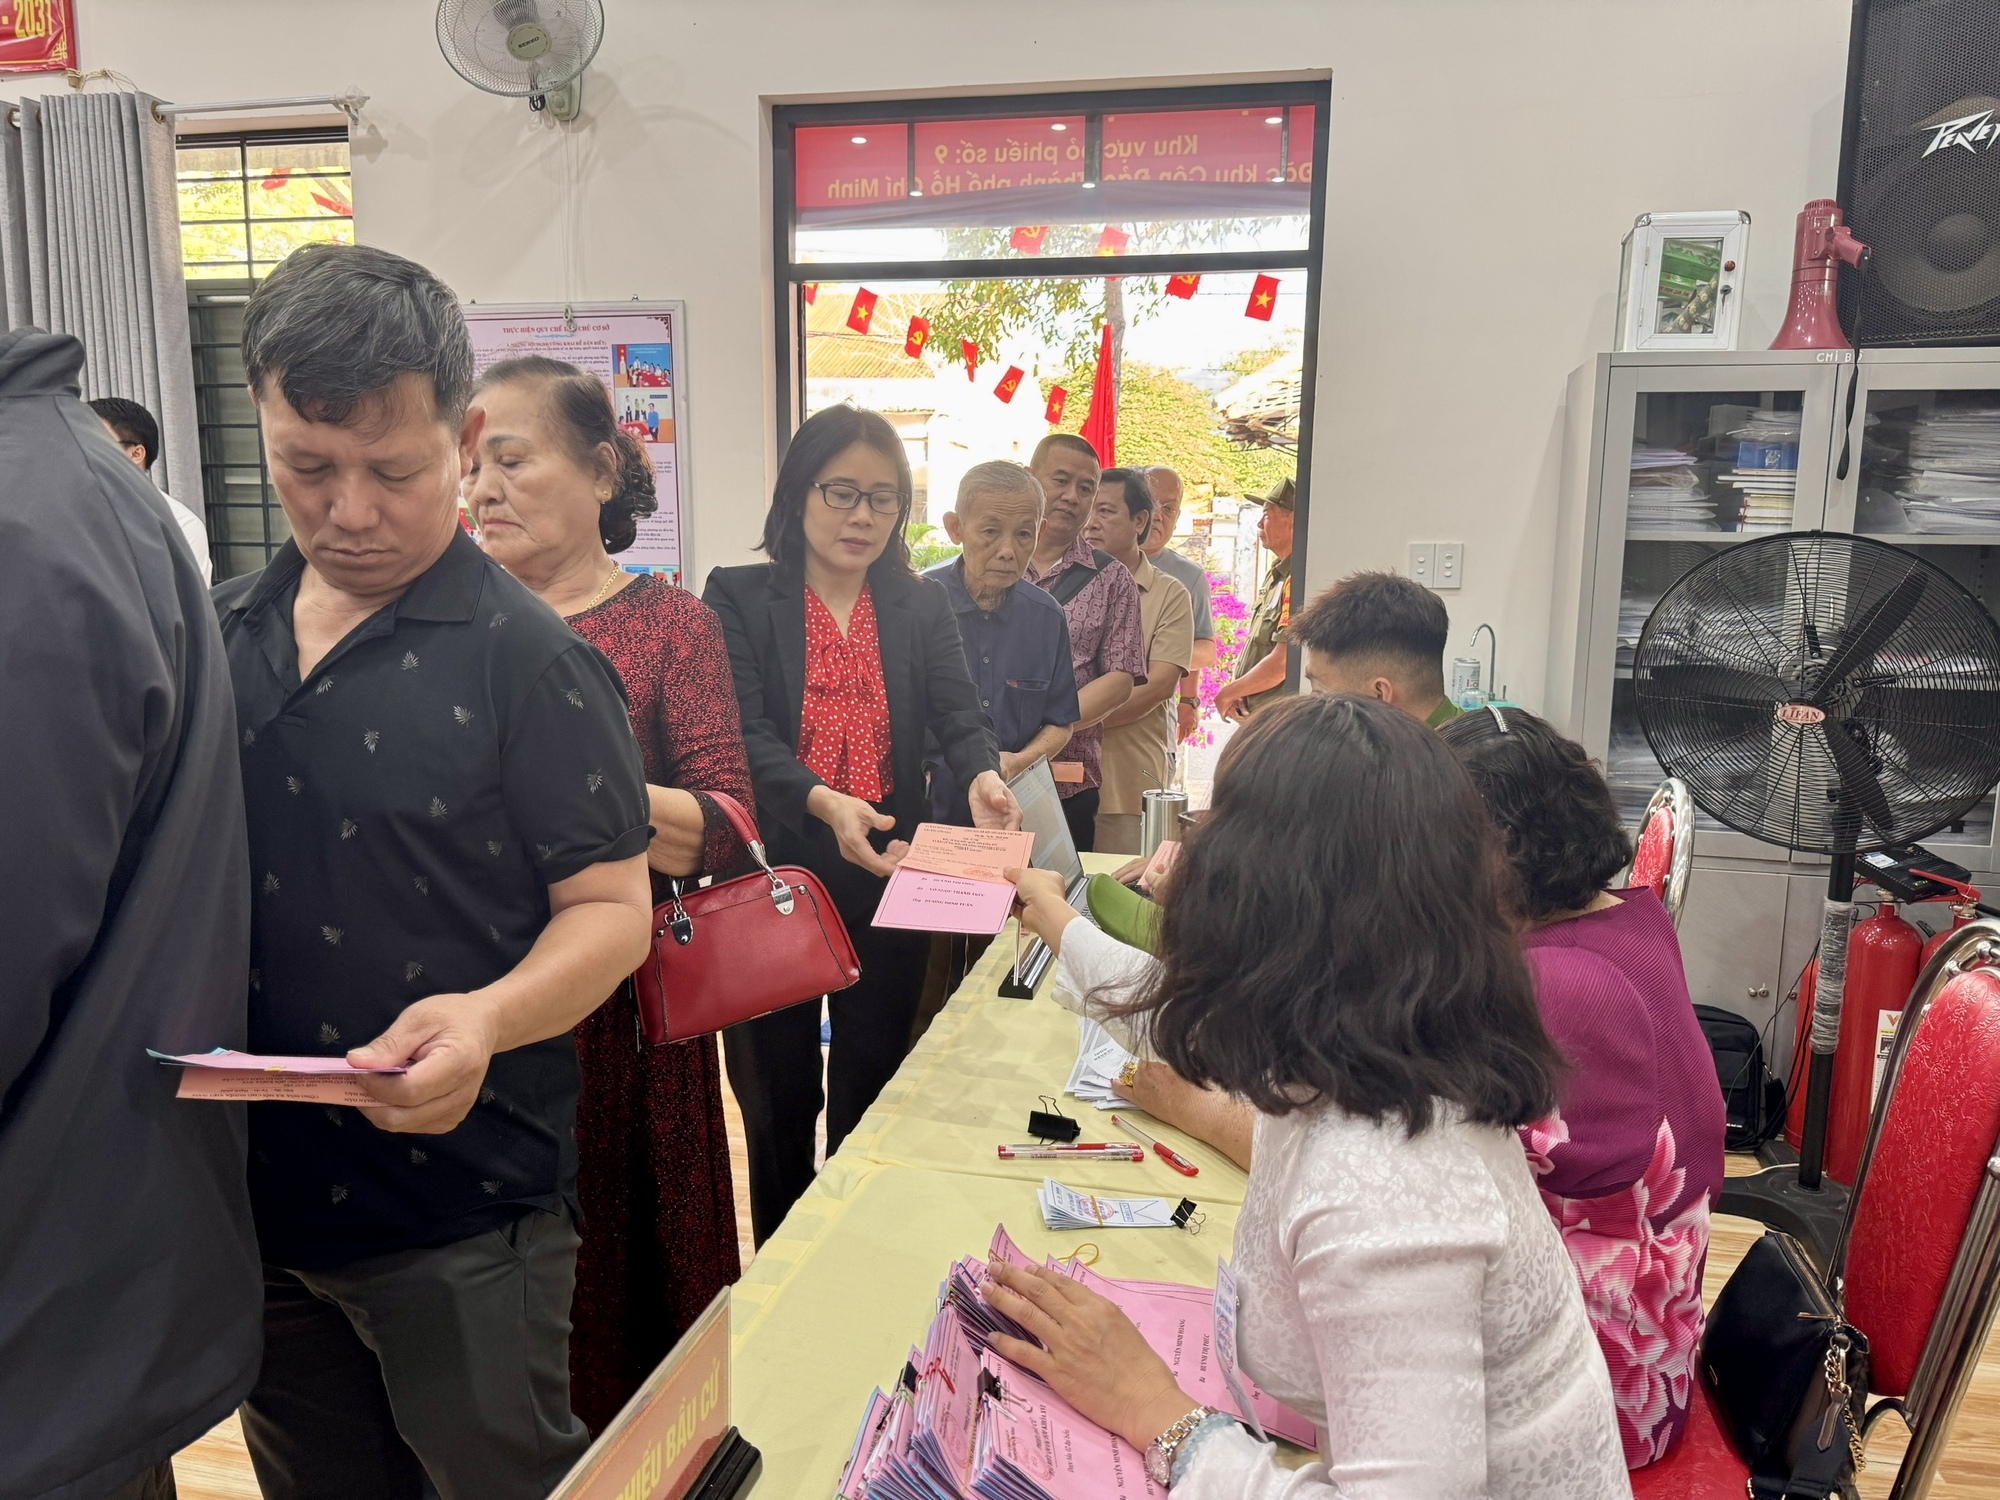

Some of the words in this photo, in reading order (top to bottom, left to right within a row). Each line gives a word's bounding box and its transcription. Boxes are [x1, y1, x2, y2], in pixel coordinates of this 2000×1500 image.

[13, 0, 52, 38] 2031
[1781, 707, 1820, 720] LIFAN
[1176, 1319, 1185, 1334] HOÀNG
[1176, 1334, 1184, 1347] MINH
[1173, 1347, 1182, 1366] NGUYỄN
[1200, 1355, 1208, 1372] HUỲNH
[666, 1394, 698, 1470] BẦU
[700, 1357, 721, 1422] CỬ
[1109, 1432, 1118, 1449] HOÀN
[1114, 1464, 1125, 1488] NGUYỄN
